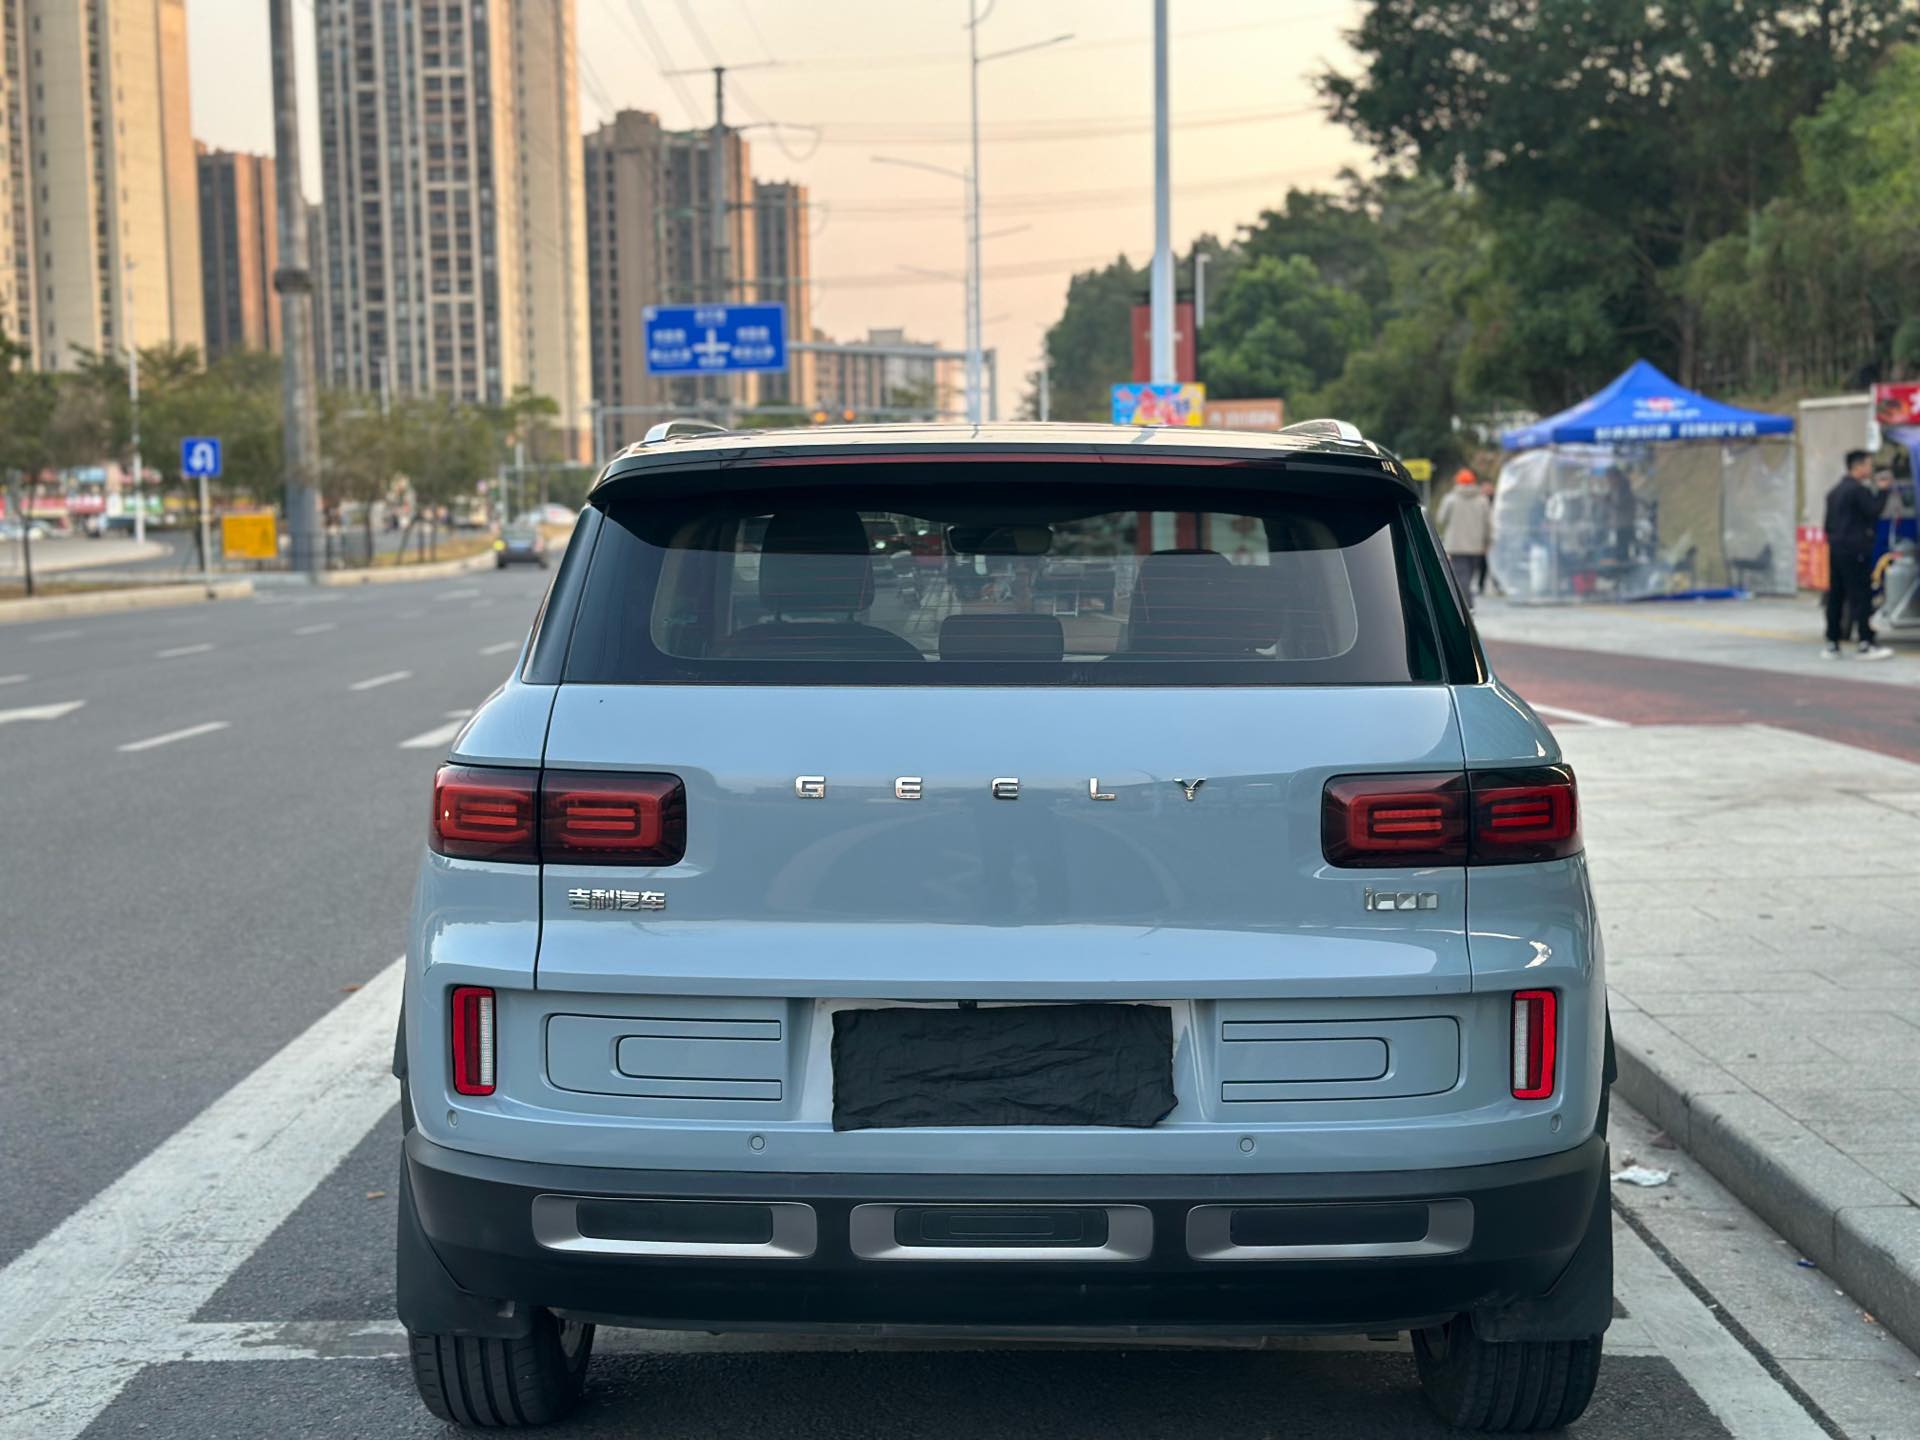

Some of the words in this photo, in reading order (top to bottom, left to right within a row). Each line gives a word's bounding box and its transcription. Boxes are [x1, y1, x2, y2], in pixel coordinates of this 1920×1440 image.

[795, 776, 1207, 801] GEELY
[568, 888, 666, 911] 吉利汽车
[1364, 887, 1438, 911] icon
